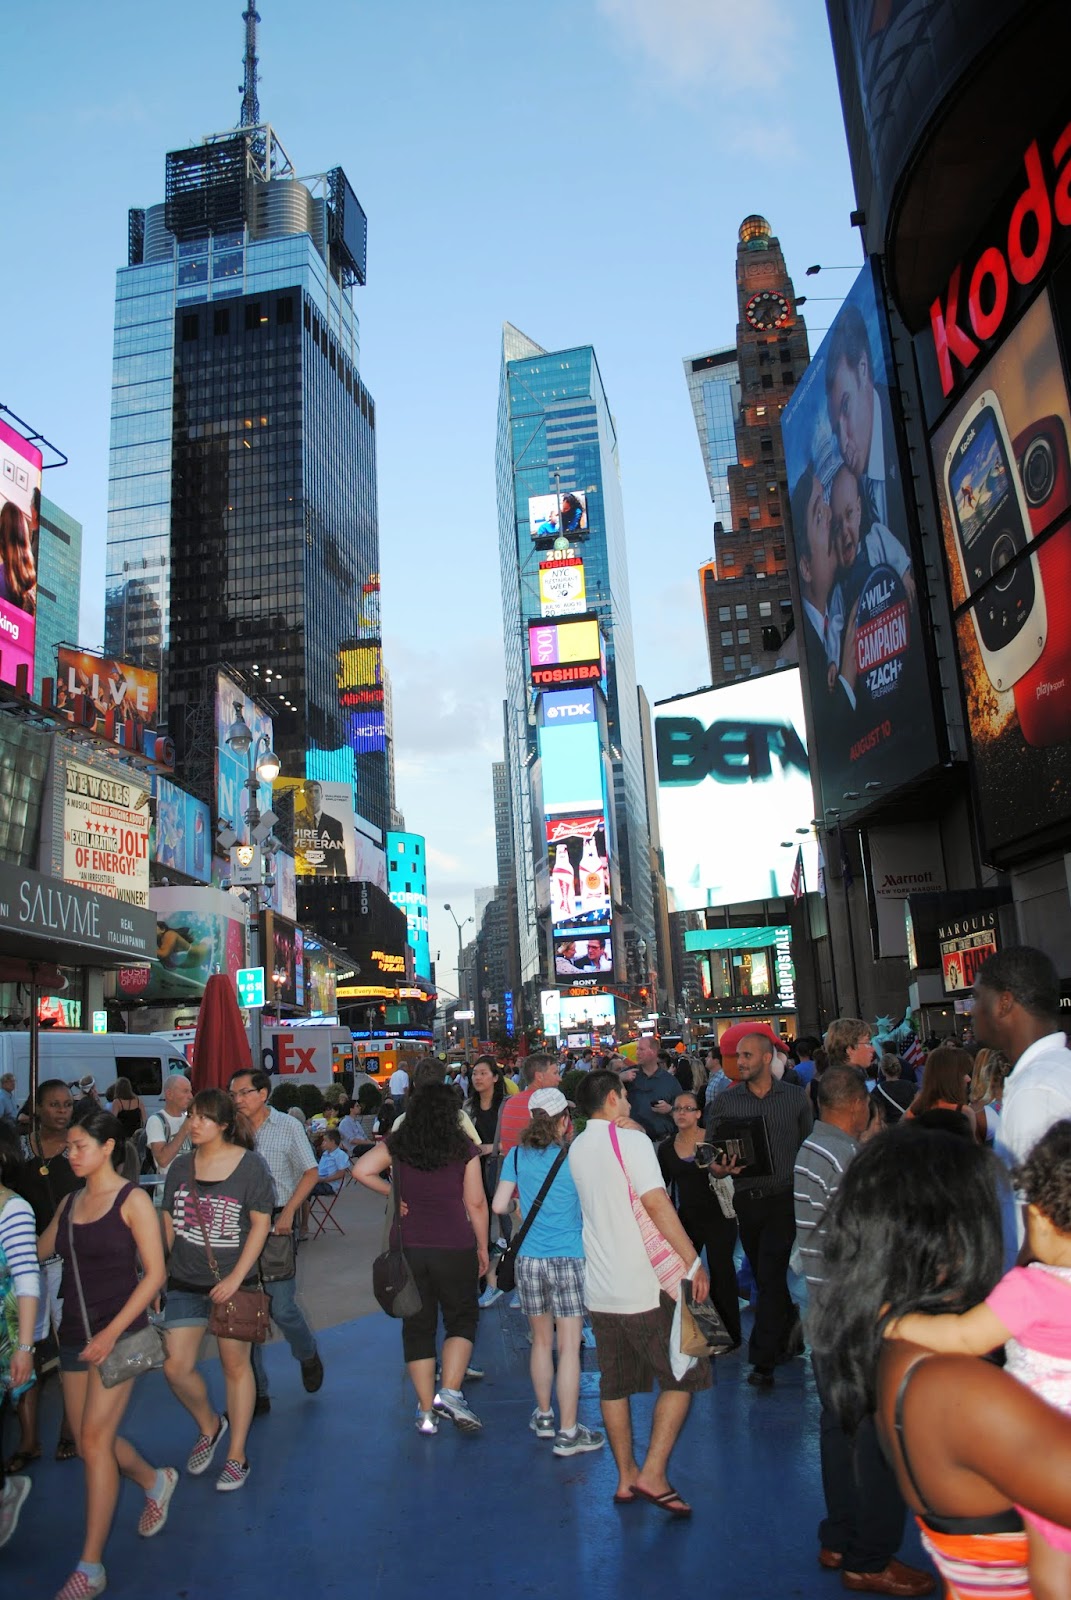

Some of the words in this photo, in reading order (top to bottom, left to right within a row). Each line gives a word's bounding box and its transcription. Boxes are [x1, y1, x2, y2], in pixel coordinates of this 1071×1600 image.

[960, 428, 976, 454] Kodak
[540, 558, 582, 569] TOSHIBA
[546, 549, 575, 561] 2012
[552, 568, 569, 577] NYC
[550, 582, 573, 590] WEEK
[866, 580, 891, 611] WILL
[869, 603, 889, 619] FERRELL
[857, 614, 907, 670] CAMPAIGN
[532, 664, 600, 684] TOSHIBA
[870, 659, 898, 691] ZACH
[68, 667, 149, 712] LIVE
[557, 703, 591, 717] TDK
[850, 726, 880, 761] AUGUST
[881, 720, 892, 738] 10
[67, 770, 130, 807] NEWSIES
[71, 799, 91, 812] MUSICAL
[92, 803, 109, 817] WORTH
[110, 808, 129, 822] SINGING
[294, 829, 318, 839] HIRE
[321, 830, 330, 840] A
[551, 824, 598, 836] Budweiser
[72, 830, 117, 853] EXHILARATING
[118, 828, 148, 858] JOLT
[294, 839, 346, 850] VETERAN
[75, 847, 90, 868] OF
[88, 873, 115, 885] IRRESISTIBLE
[882, 871, 932, 887] Marriott
[360, 881, 369, 915] 1500
[120, 918, 134, 931] REAL
[938, 912, 995, 939] MARQUIS
[108, 930, 129, 946] ITALIAN
[129, 934, 146, 950] PANINI
[121, 967, 147, 976] PUSH
[354, 988, 371, 996] Every
